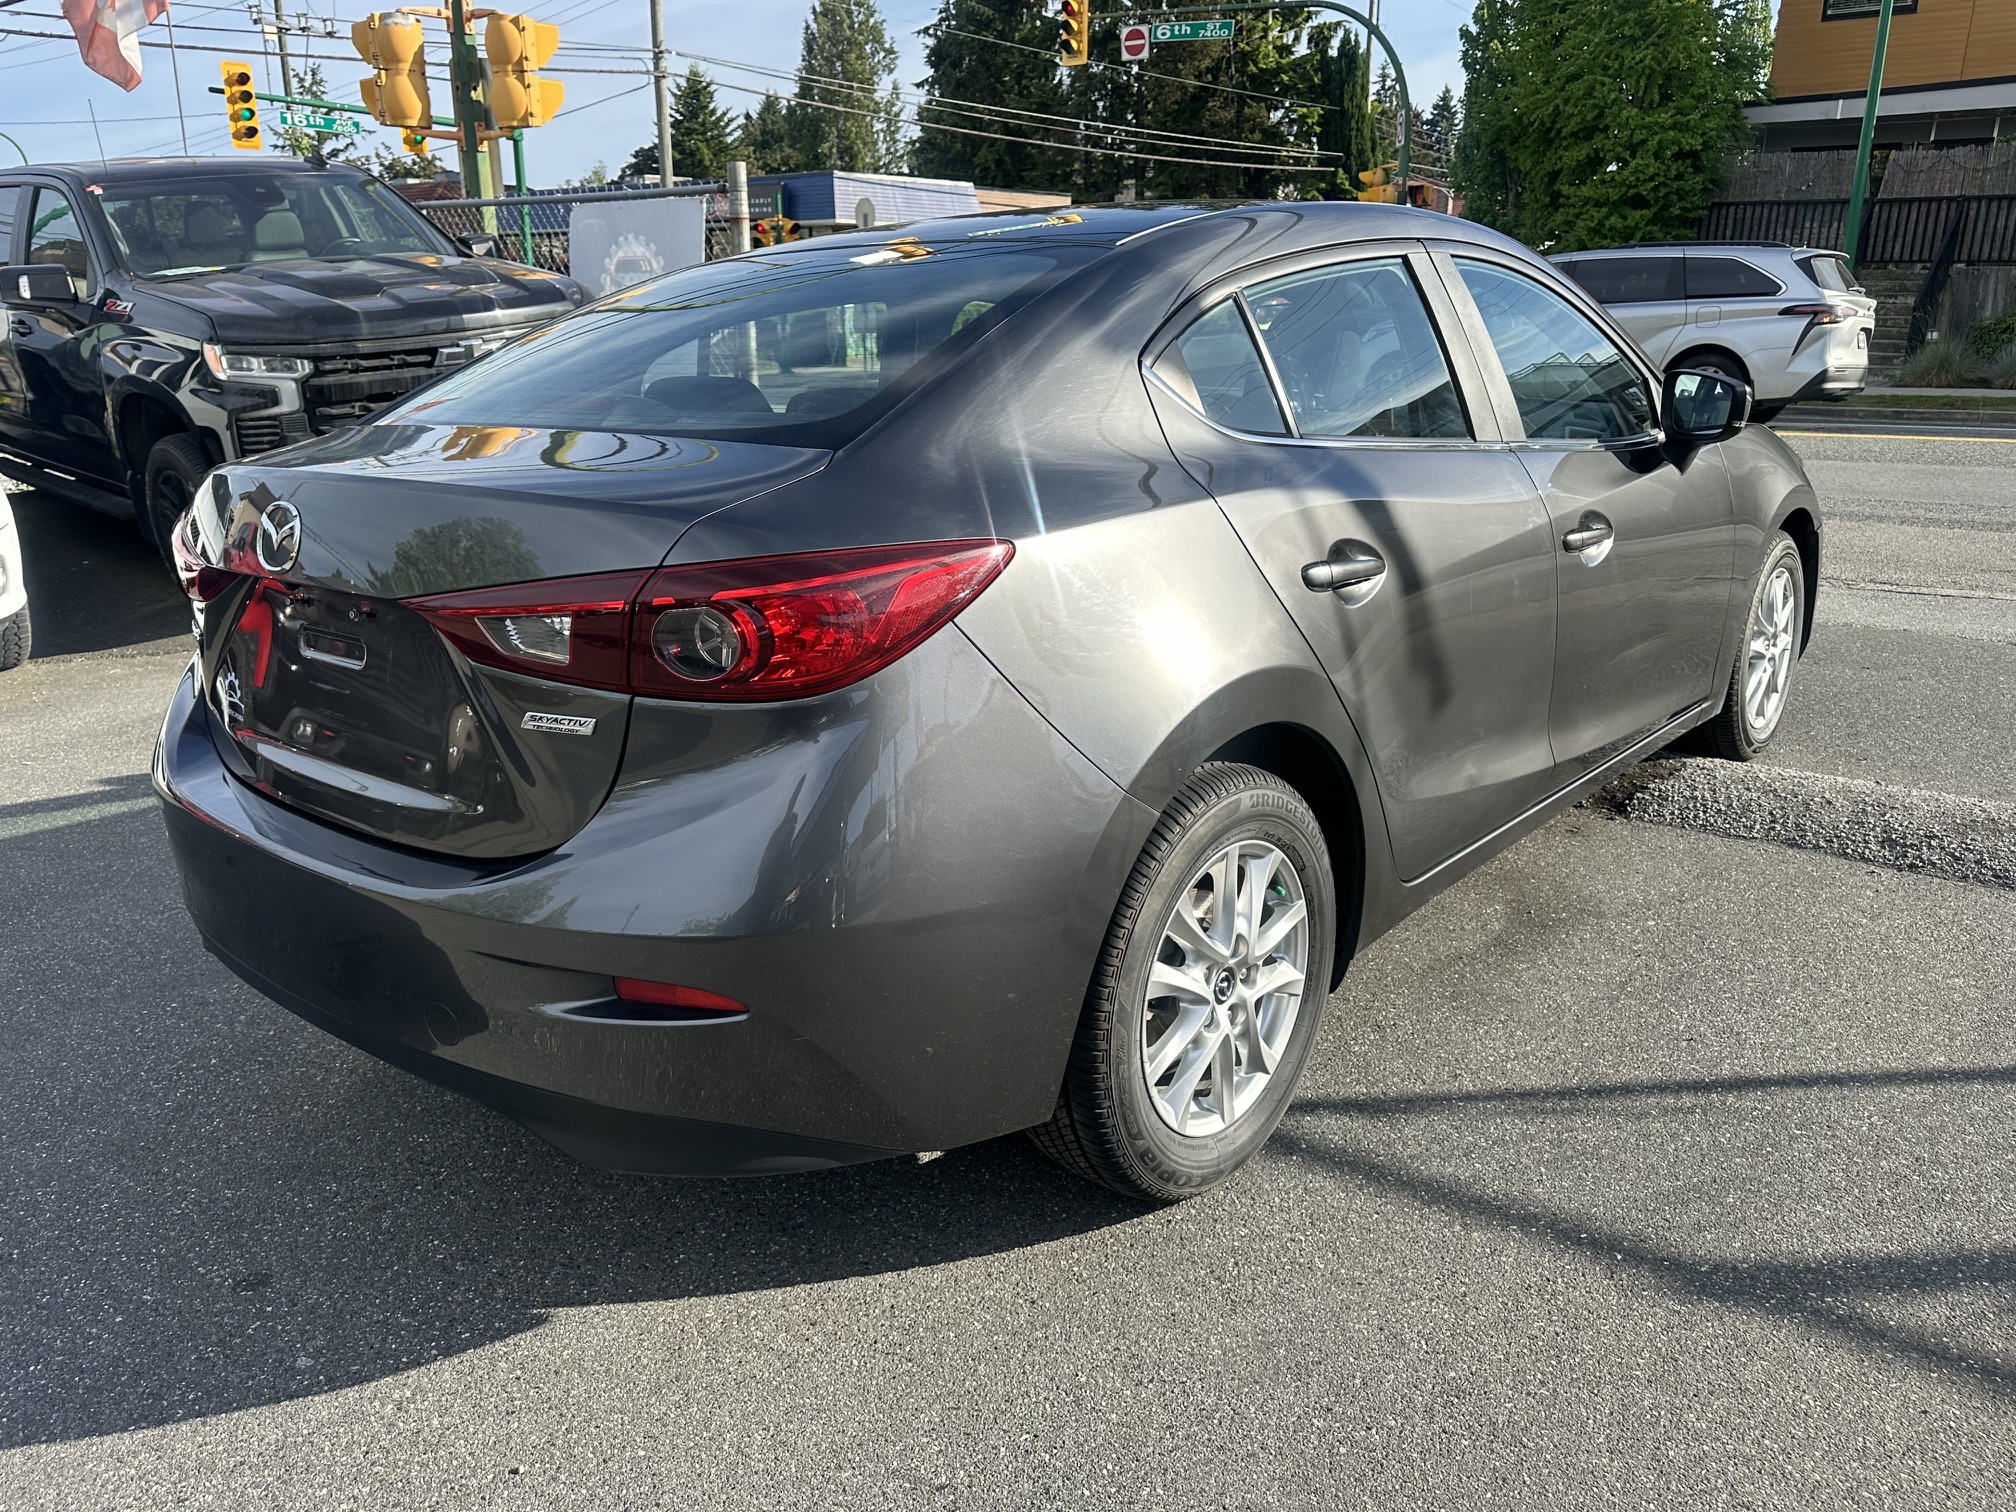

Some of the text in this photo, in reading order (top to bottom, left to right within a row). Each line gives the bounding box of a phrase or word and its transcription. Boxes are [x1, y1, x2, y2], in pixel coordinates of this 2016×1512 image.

[1156, 24, 1191, 39] 6th
[1198, 29, 1228, 37] 7400
[1206, 22, 1221, 30] ST
[282, 112, 325, 127] 16th
[103, 299, 134, 314] Z71
[528, 714, 588, 727] SKYACTIV
[532, 725, 579, 733] TECHNOLOGY
[1250, 793, 1327, 860] BRIDGESTONE
